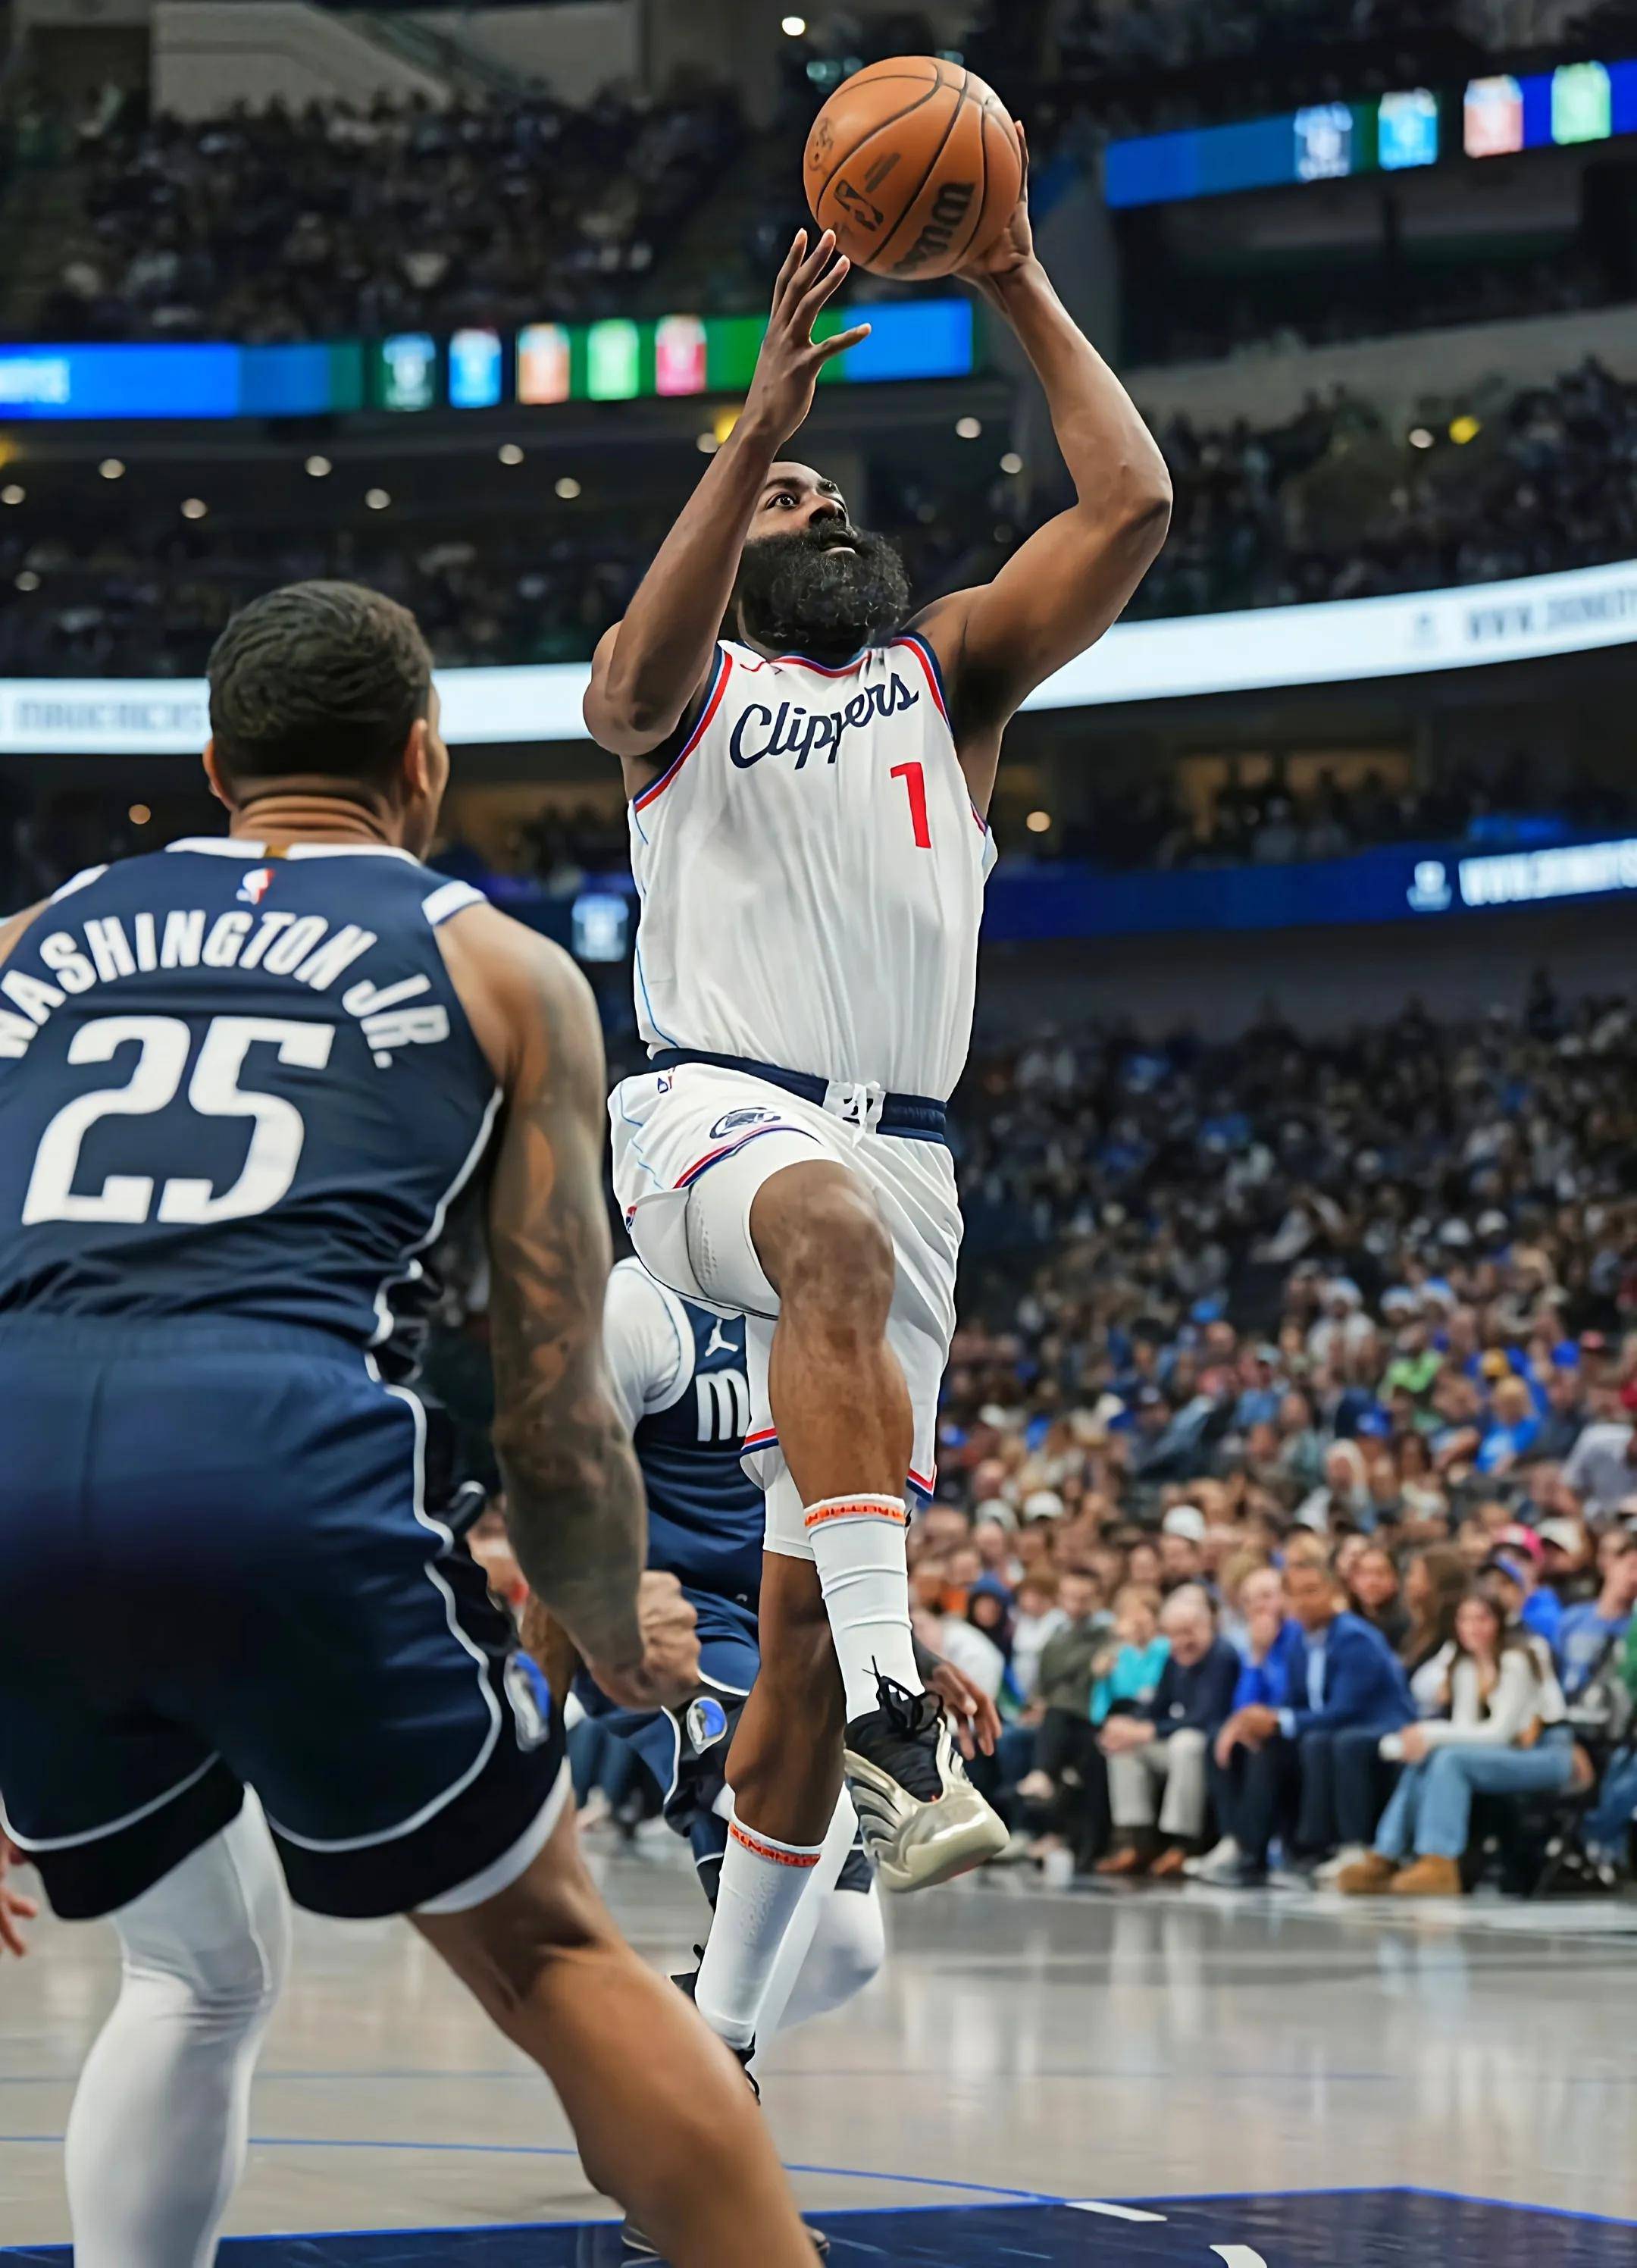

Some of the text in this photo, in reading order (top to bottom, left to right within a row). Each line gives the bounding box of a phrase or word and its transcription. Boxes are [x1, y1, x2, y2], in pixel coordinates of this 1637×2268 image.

[729, 672, 919, 770] Clippers
[890, 762, 932, 849] 1
[342, 974, 450, 1069] JR.
[21, 1015, 336, 1226] 25
